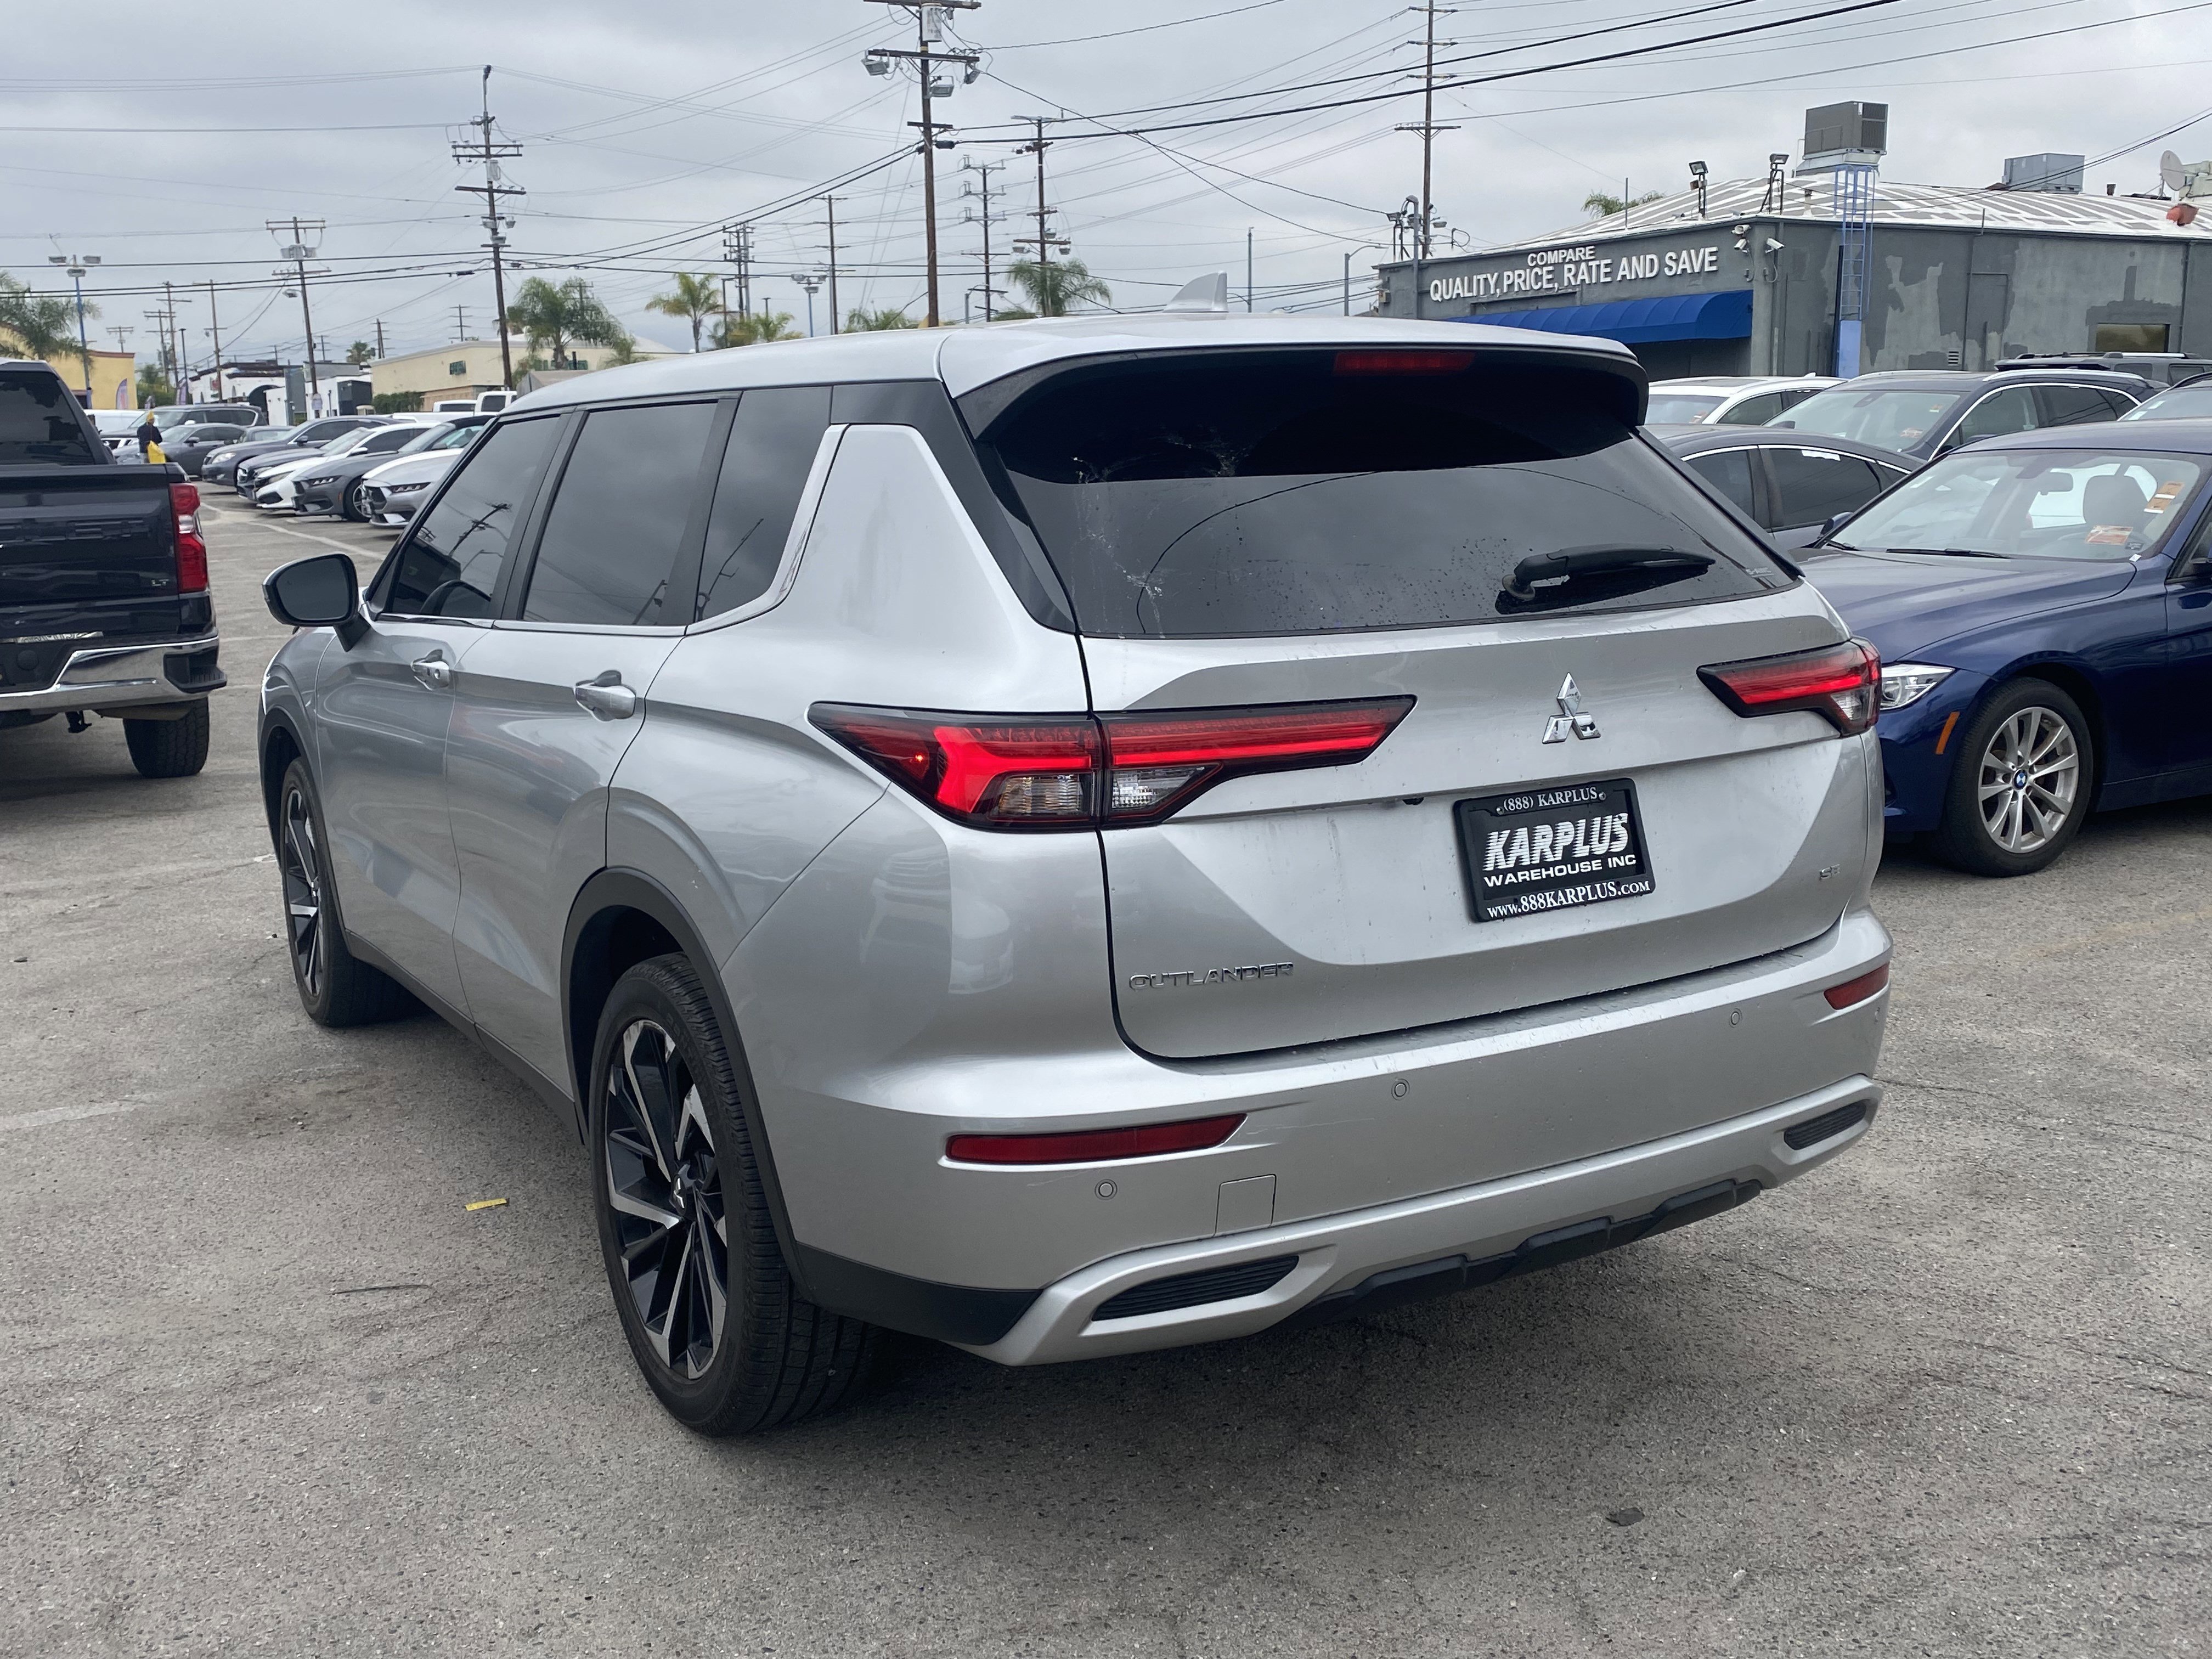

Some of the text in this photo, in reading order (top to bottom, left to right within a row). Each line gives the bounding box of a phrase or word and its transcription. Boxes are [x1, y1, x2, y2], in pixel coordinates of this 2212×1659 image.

[1527, 246, 1596, 267] COMPARE
[1430, 246, 1719, 302] QUALITY, PRICE, RATE AND SAVE
[1503, 787, 1598, 811] (888) KARPLUS
[1482, 812, 1628, 871] KARPLUS
[1483, 854, 1637, 888] WAREHOUSE INC
[1129, 962, 1294, 990] OUTLANDER
